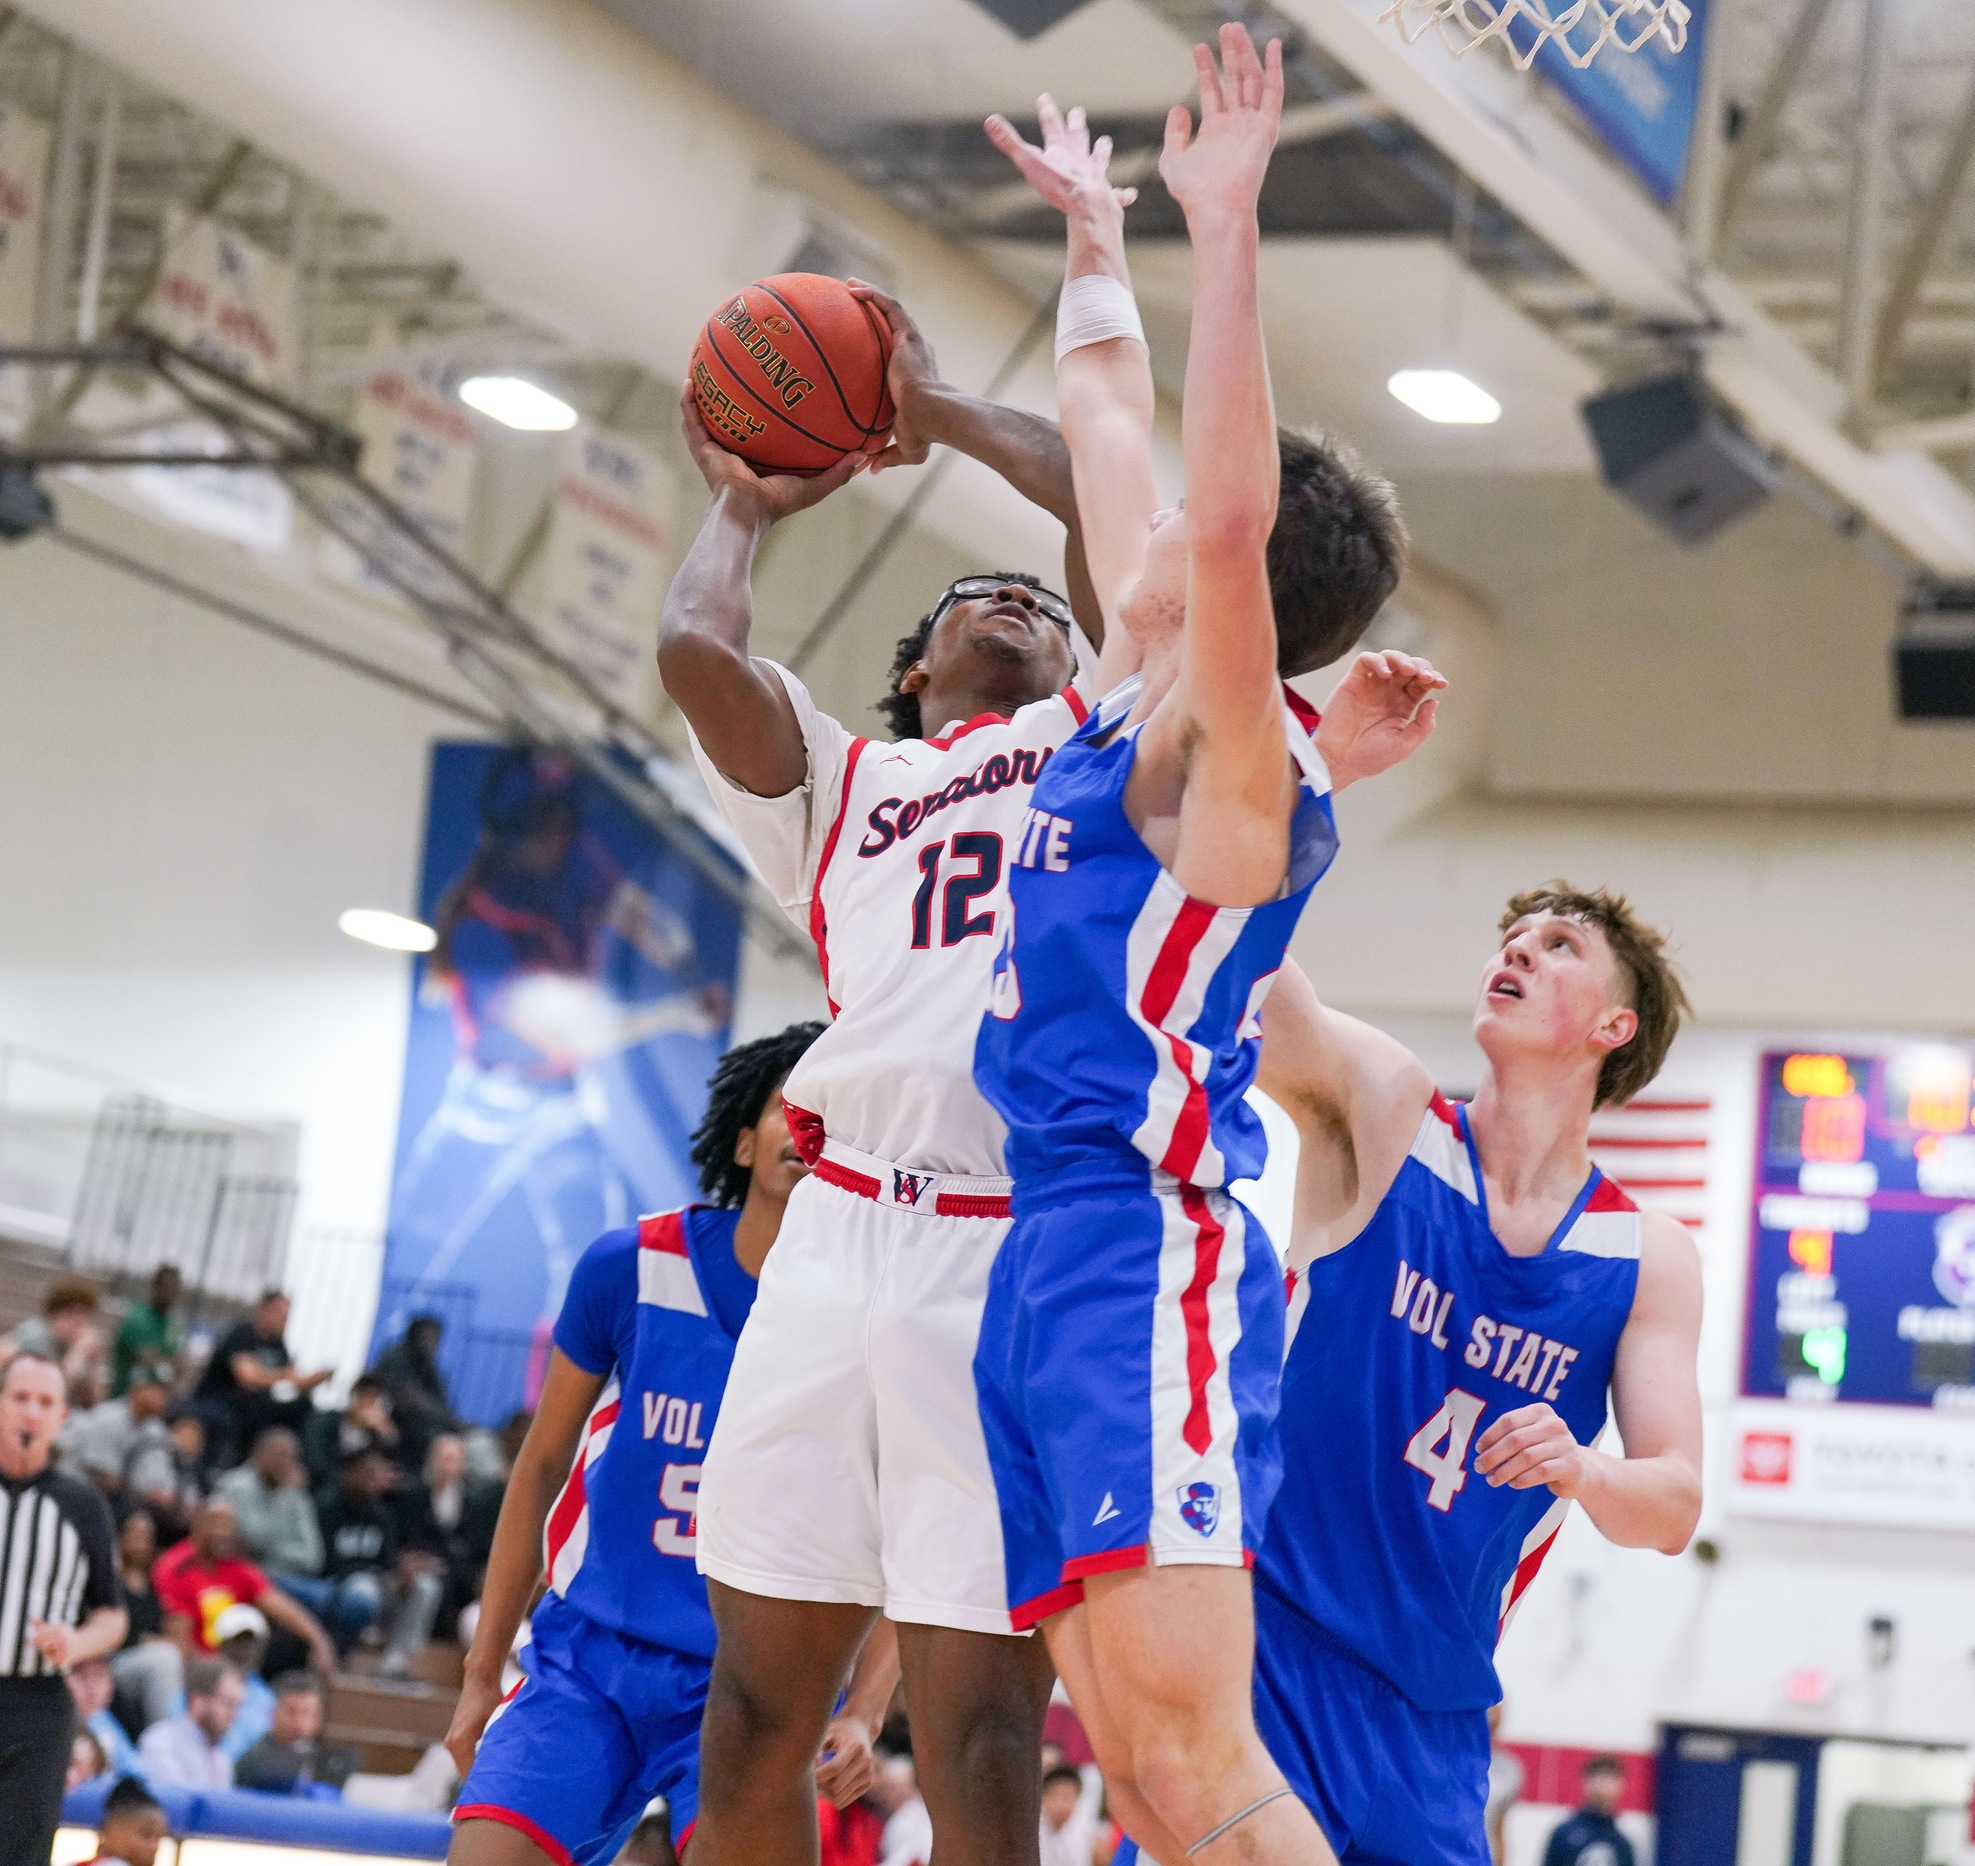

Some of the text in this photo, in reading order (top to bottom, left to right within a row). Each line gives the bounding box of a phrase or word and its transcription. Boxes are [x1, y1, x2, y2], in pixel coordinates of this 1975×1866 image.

[715, 295, 816, 410] SPALDING
[910, 831, 1003, 950] 12
[1390, 1258, 1579, 1402] VOL STATE
[642, 1391, 704, 1449] VOL
[1402, 1385, 1487, 1513] 4
